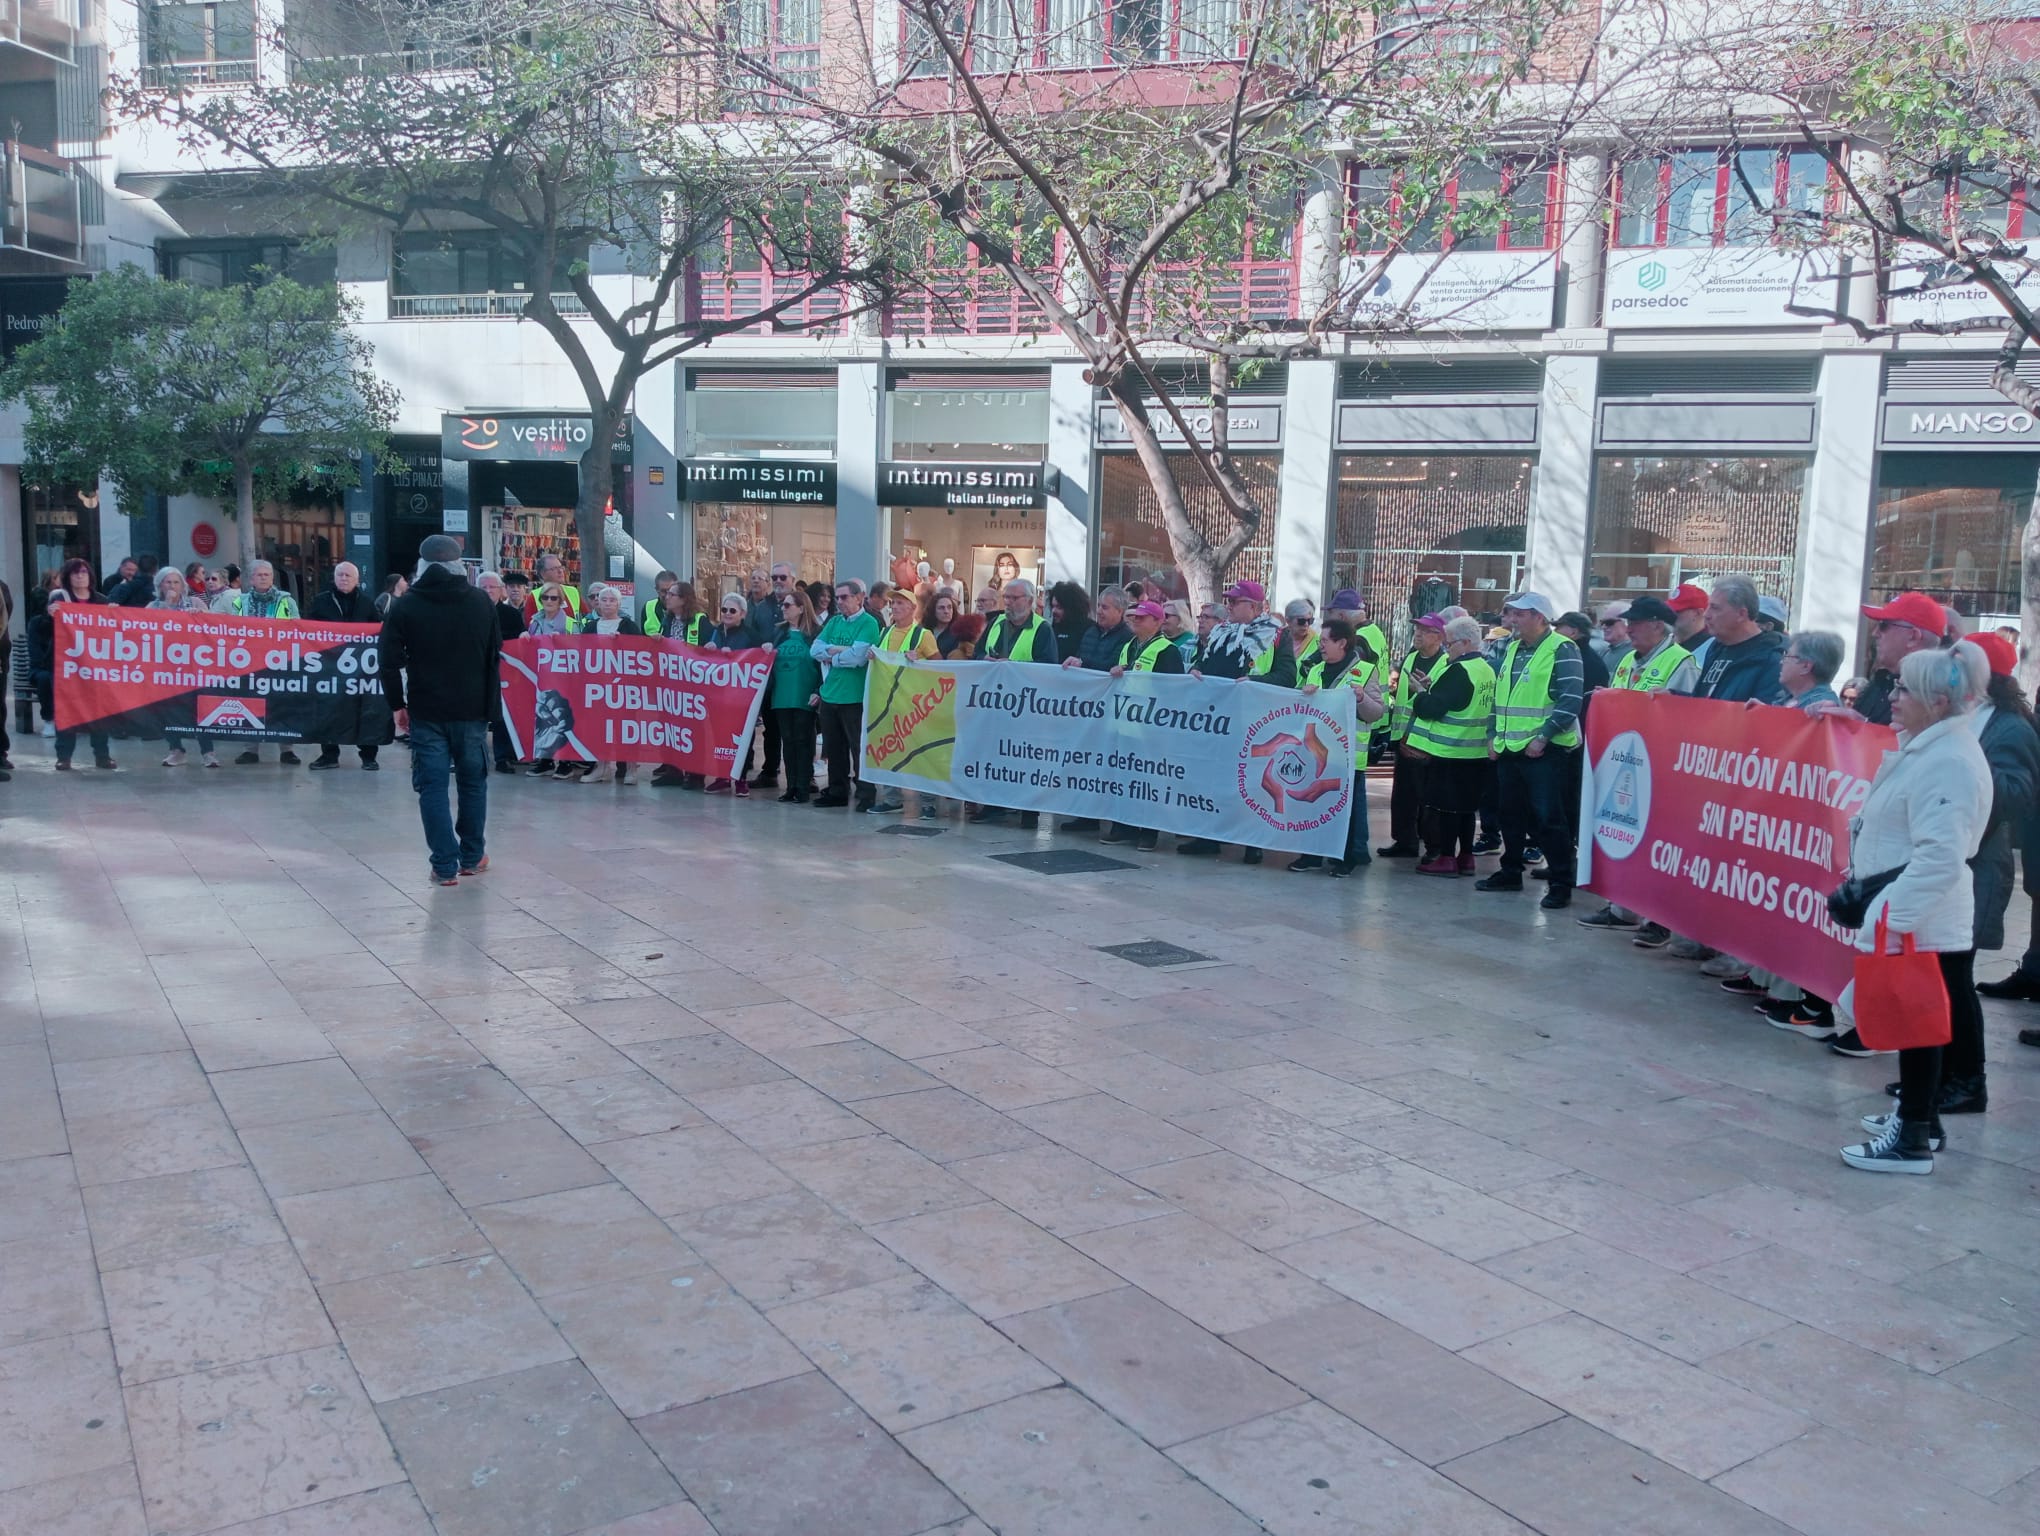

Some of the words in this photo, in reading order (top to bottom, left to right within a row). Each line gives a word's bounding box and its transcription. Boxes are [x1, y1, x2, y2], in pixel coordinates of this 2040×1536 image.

[1706, 286, 1745, 294] procesos
[1777, 276, 1789, 284] de
[1611, 294, 1689, 311] parsedoc
[7, 314, 39, 330] Pedro
[511, 419, 587, 442] vestito
[1229, 418, 1259, 430] EEN
[1910, 412, 2033, 433] MANGO
[687, 464, 824, 483] intimissimi
[888, 467, 1034, 487] intimissimi
[743, 489, 777, 500] Italian
[781, 489, 823, 502] lingerie
[947, 492, 984, 504] Italian
[986, 493, 1033, 507] lingerie
[62, 612, 93, 626] N'hi
[98, 615, 117, 628] ha
[122, 619, 158, 631] prou
[163, 620, 182, 632] de
[187, 623, 264, 638] retallades
[269, 627, 273, 638] i
[64, 630, 252, 669] Jubilació
[264, 643, 323, 673] als
[63, 661, 145, 683] Pensió
[153, 667, 241, 689] mínima
[249, 673, 308, 695] igual
[316, 676, 337, 694] al
[537, 648, 580, 673] PER
[585, 648, 654, 676] UNES
[659, 657, 769, 690] PENSIONS
[585, 678, 707, 721] PÚBLIQUES
[966, 684, 1106, 719] Iaioflautas
[1113, 694, 1231, 736] Valencia
[218, 716, 245, 726] CGT
[1293, 703, 1342, 734] Valenciana
[605, 719, 613, 744] I
[622, 720, 693, 754] DIGNES
[1239, 706, 1291, 759] Coordinadora
[999, 739, 1059, 763] Lluitem
[1061, 750, 1091, 768] per
[1096, 753, 1103, 765] a
[1108, 750, 1186, 780] defendre
[1673, 741, 1779, 792] JUBILACIÓN
[964, 761, 979, 779] el
[985, 763, 1026, 785] futur
[1031, 769, 1061, 788] dels
[1067, 776, 1124, 797] nostres
[1129, 780, 1159, 803] fills
[1165, 786, 1171, 805] i
[1177, 792, 1221, 814] nets.
[1237, 762, 1249, 798] Defensa
[1245, 798, 1259, 812] del
[1257, 808, 1285, 831] Sistema
[1287, 820, 1320, 832] Publico
[1319, 813, 1330, 825] de
[1598, 825, 1635, 845] ASJUBI40
[1698, 800, 1725, 838] SIN
[1728, 808, 1834, 872] PENALIZAR
[1650, 839, 1681, 878] CON
[1682, 853, 1710, 890] +40
[1712, 858, 1780, 912] AÑOS
